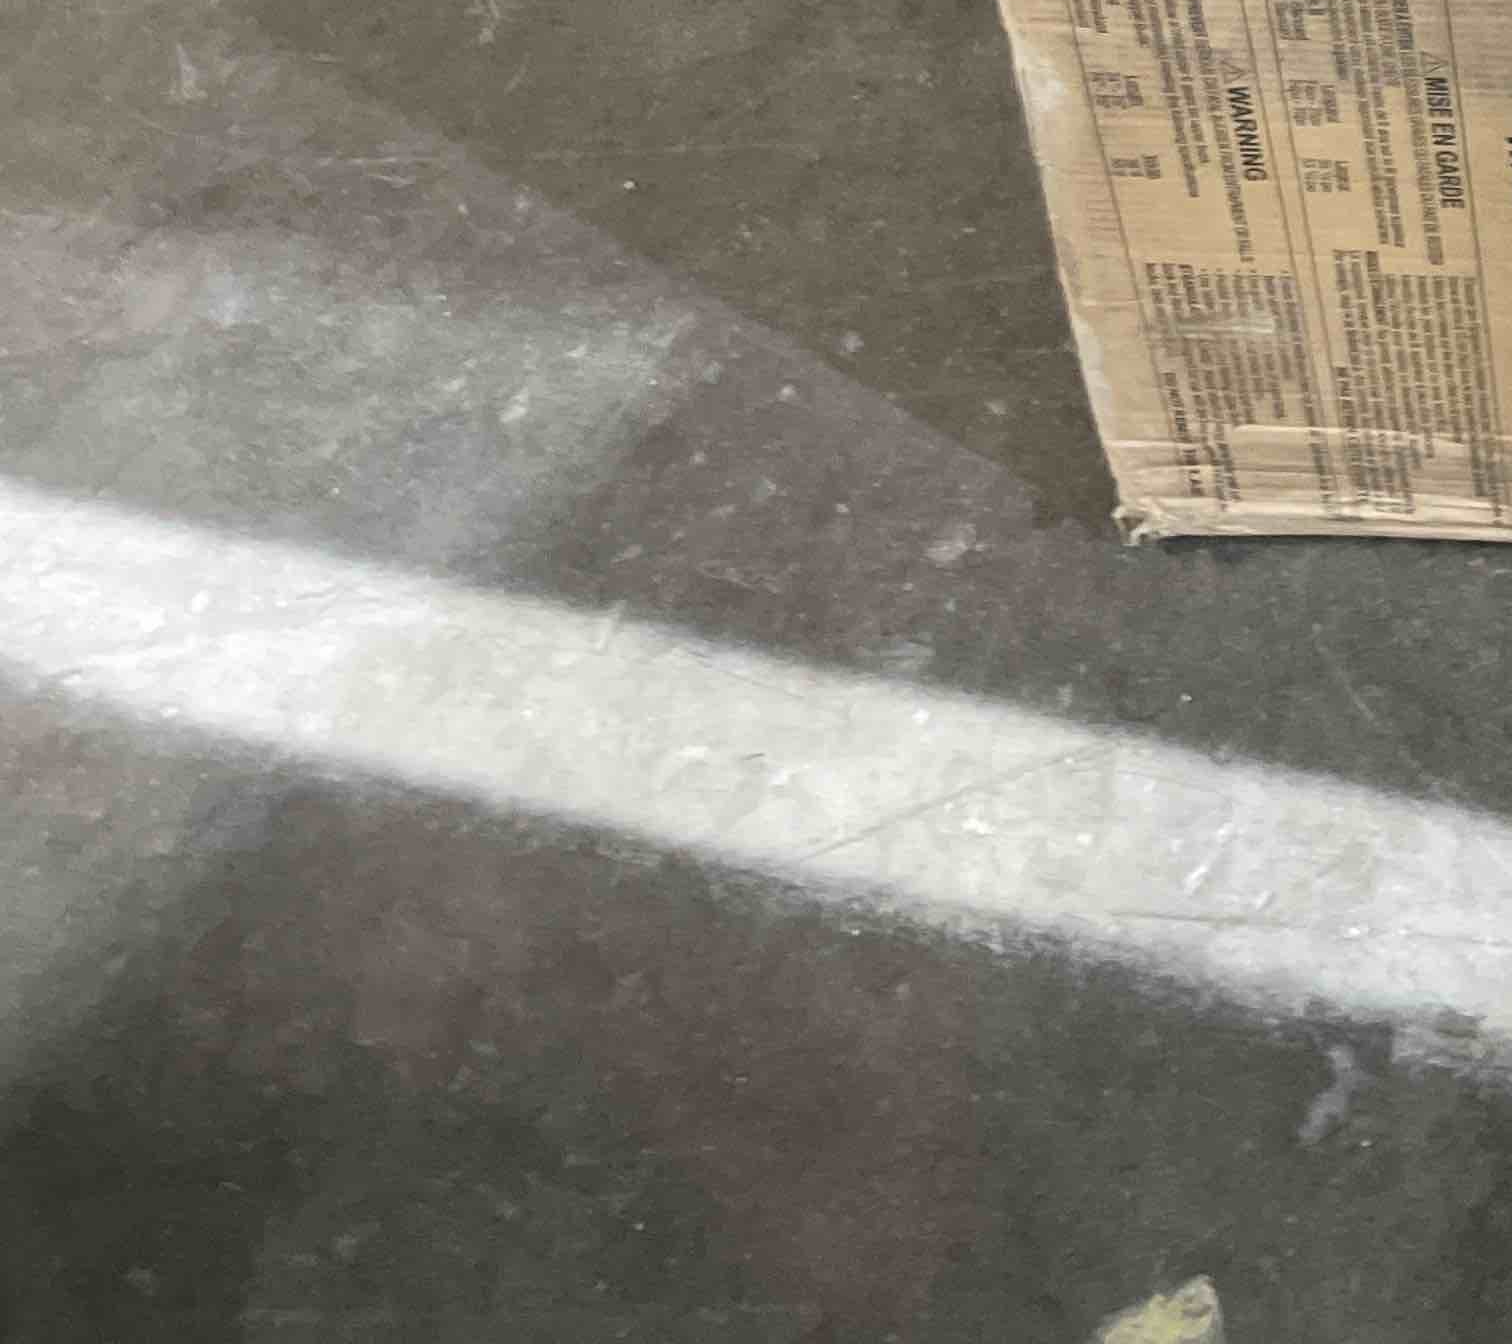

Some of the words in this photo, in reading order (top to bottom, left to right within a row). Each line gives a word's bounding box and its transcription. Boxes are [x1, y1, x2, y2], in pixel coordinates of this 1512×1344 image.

[1424, 77, 1455, 118] MISE
[1226, 86, 1267, 181] WARNING
[1431, 123, 1458, 146] EN
[1433, 151, 1463, 208] GARDE
